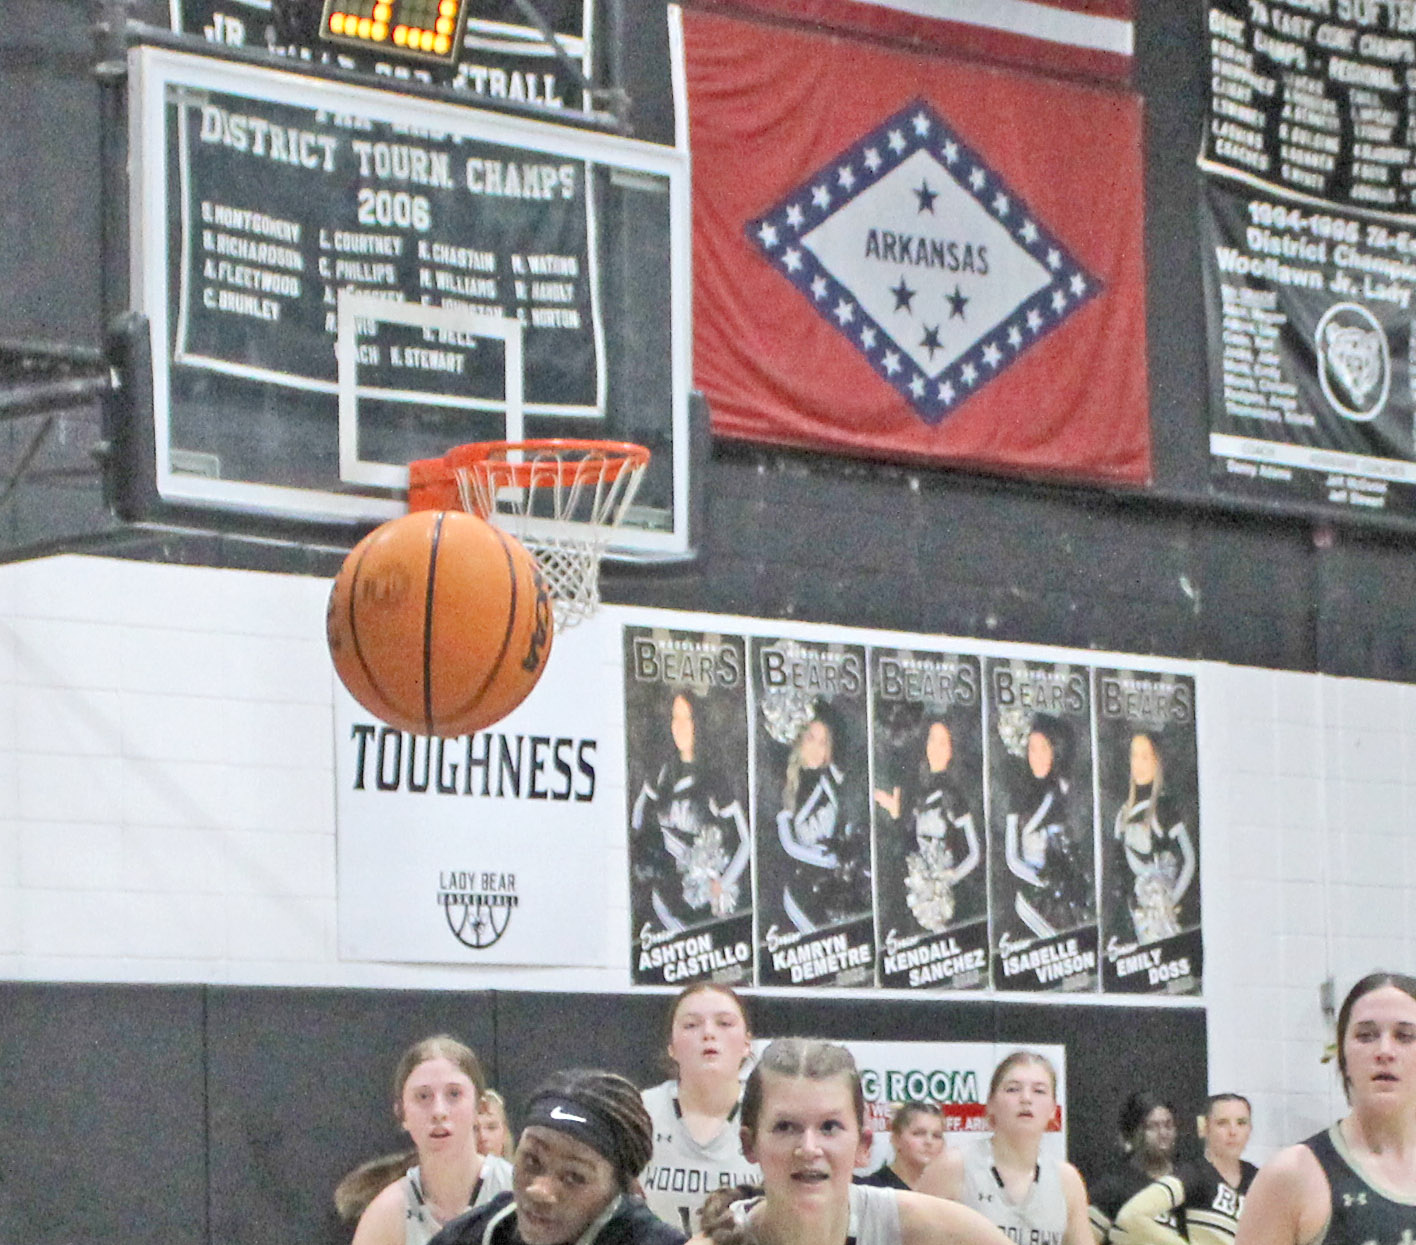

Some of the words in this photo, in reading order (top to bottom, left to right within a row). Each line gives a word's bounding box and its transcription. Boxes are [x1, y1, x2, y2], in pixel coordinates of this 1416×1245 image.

[202, 105, 337, 172] DISTRICT
[466, 157, 575, 200] CHAMPS
[358, 188, 431, 231] 2006
[865, 228, 990, 275] ARKANSAS
[1247, 226, 1327, 263] District
[217, 260, 300, 298] FLEETWOOD
[1363, 274, 1411, 308] Lady
[634, 637, 739, 687] BEARS
[760, 646, 860, 697] BEARS
[880, 657, 976, 706] BEARS
[994, 665, 1087, 715] BEARS
[1101, 677, 1192, 724] BEARS
[351, 724, 597, 803] TOUGHNESS
[440, 872, 475, 890] LADY
[481, 873, 515, 892] BEAR
[639, 933, 713, 971] ASHTON
[663, 942, 749, 982] CASTILLO
[773, 933, 848, 970] KAMRYN
[791, 944, 872, 983] DEMETRE
[883, 938, 961, 974] KENDALL
[909, 949, 986, 986] SANCHEZ
[1003, 939, 1079, 977] ISABELLE
[1035, 951, 1095, 983] VINSON
[1117, 948, 1162, 977] EMILY
[1151, 958, 1190, 985] DOSS
[886, 1069, 978, 1104] ROOM
